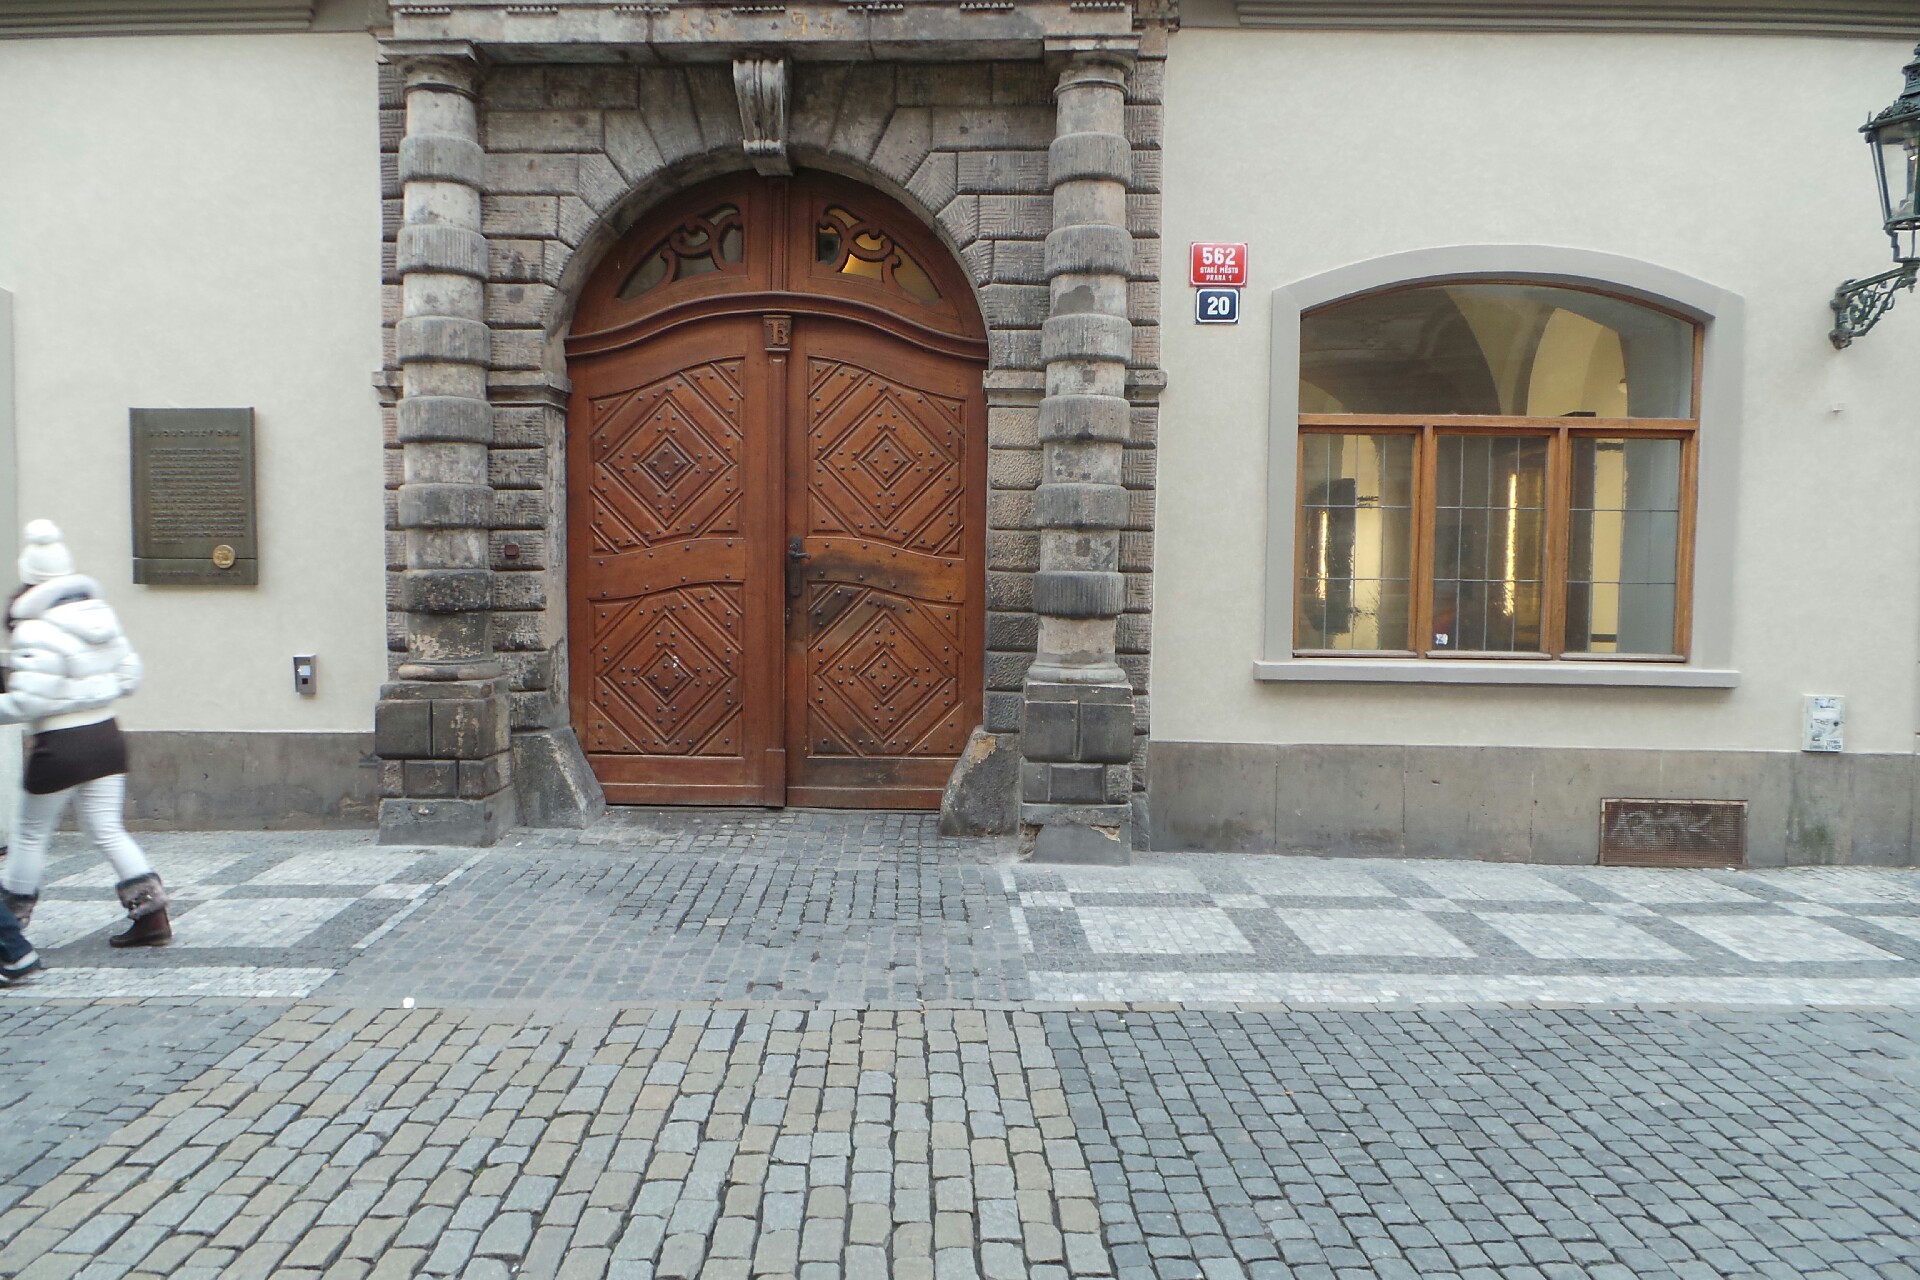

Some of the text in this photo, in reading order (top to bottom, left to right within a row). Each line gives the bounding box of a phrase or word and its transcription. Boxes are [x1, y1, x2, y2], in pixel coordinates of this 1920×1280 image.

[1203, 247, 1236, 265] 562
[1200, 265, 1238, 274] STARÉ MĚSTO
[1207, 296, 1230, 315] 20
